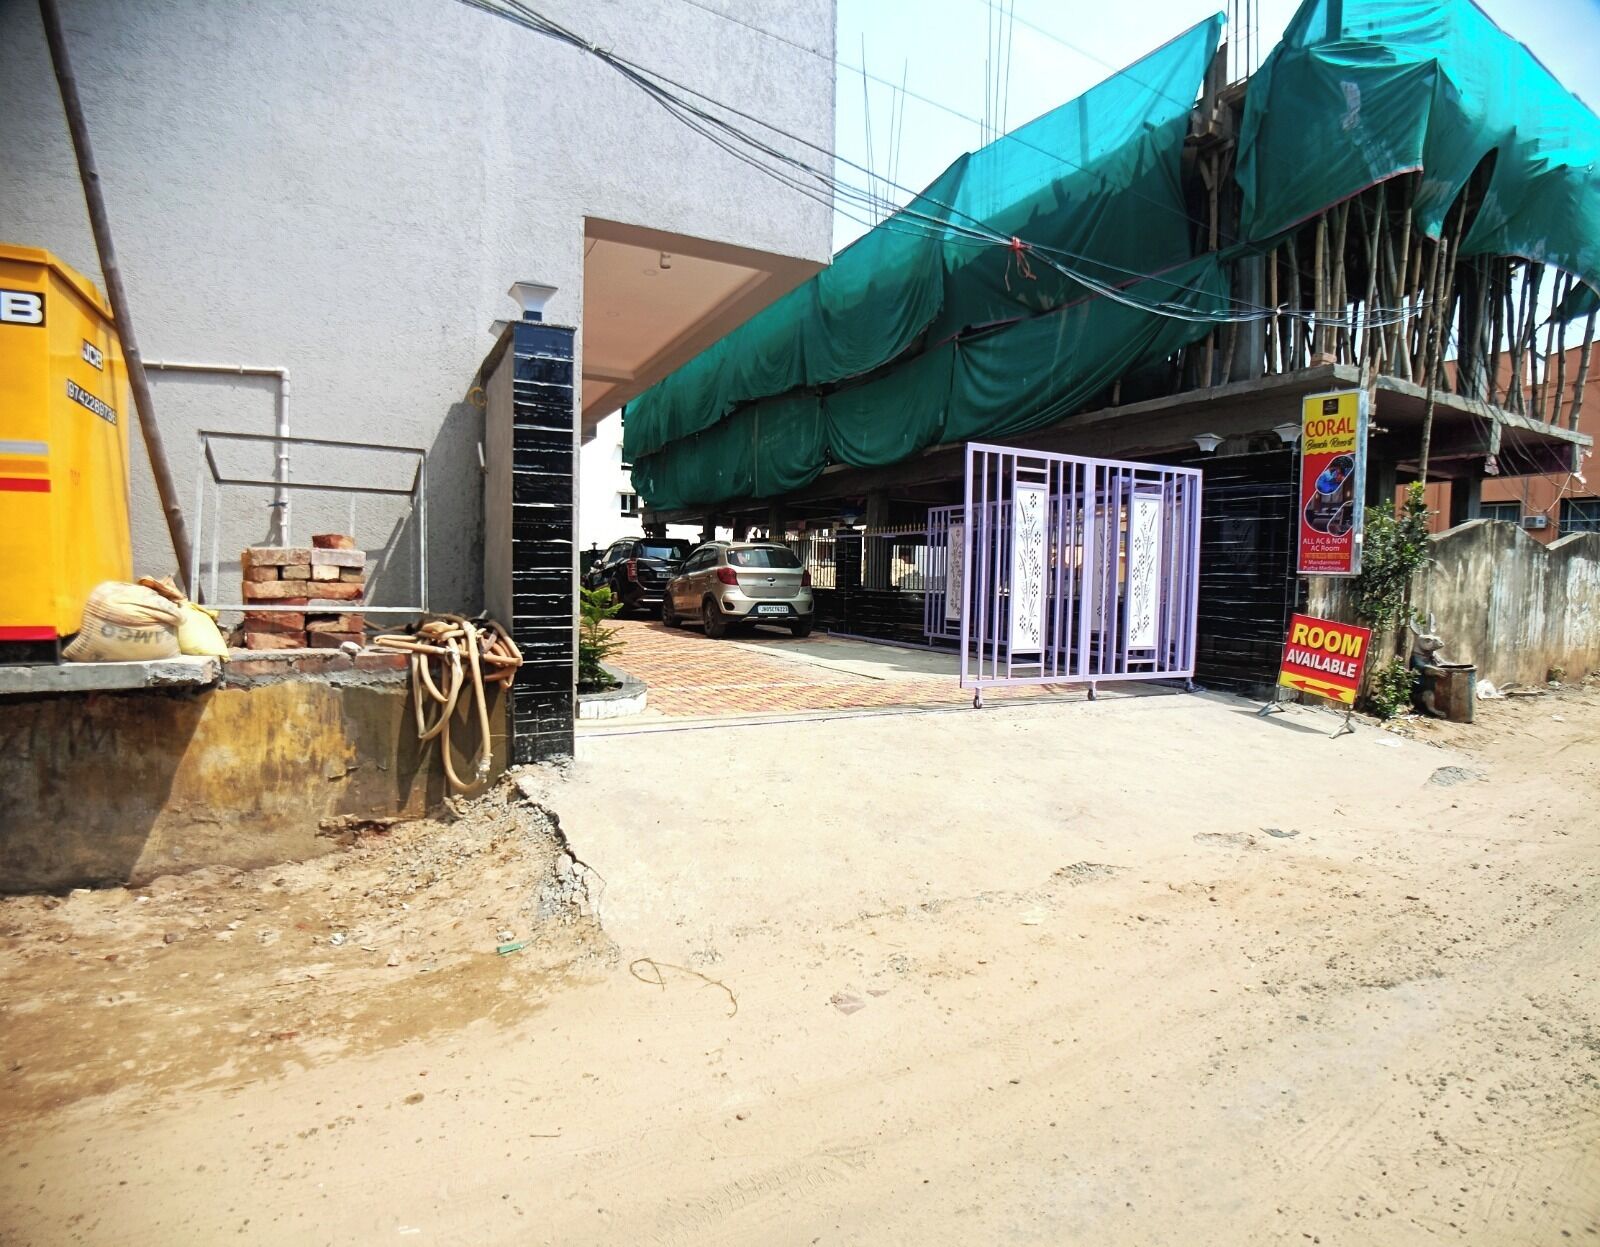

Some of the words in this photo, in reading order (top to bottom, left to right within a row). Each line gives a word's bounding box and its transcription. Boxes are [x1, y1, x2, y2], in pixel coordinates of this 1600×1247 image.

[1306, 417, 1355, 437] CORAL
[1291, 623, 1363, 658] ROOM
[1285, 648, 1357, 678] AVAILABLE
